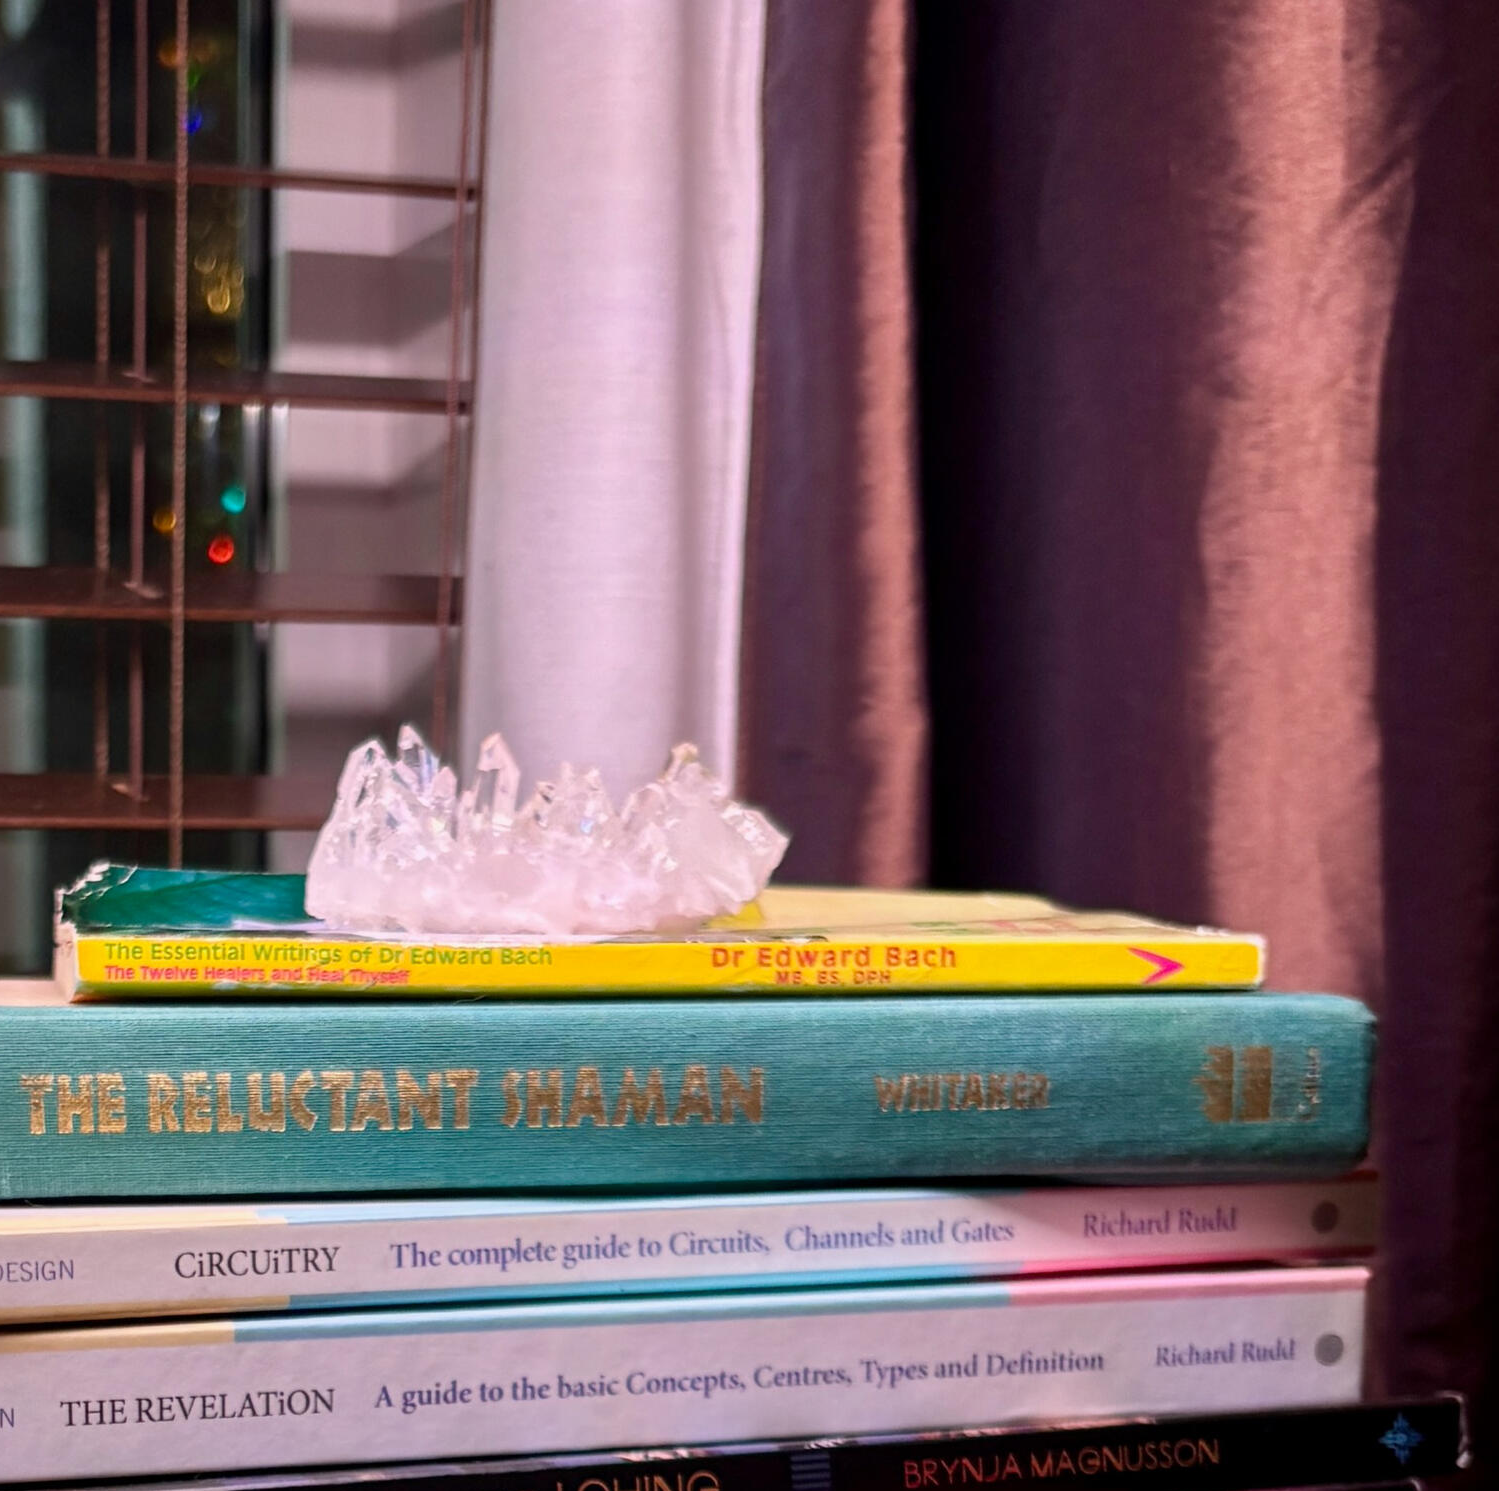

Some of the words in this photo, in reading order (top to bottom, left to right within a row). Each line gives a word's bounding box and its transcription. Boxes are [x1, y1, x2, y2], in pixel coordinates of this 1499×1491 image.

[105, 943, 142, 960] The
[150, 943, 245, 961] Essential
[252, 944, 341, 966] Writings
[350, 946, 372, 963] of
[380, 947, 403, 963] Dr
[411, 947, 492, 965] Edward
[501, 947, 552, 965] Bach
[711, 947, 744, 967] Dr
[757, 946, 870, 967] Edward
[886, 946, 957, 968] Bach
[105, 966, 135, 980] The
[141, 966, 197, 980] Twelve
[21, 1072, 126, 1137] THE
[148, 1069, 478, 1133] RELUCTANT
[502, 1064, 765, 1128] SHAMAN
[872, 1071, 1053, 1113] WHITAKER
[1082, 1209, 1171, 1238] Richard
[1179, 1207, 1239, 1235] Rudd
[390, 1242, 441, 1270] The
[448, 1238, 556, 1272] complete
[563, 1233, 632, 1269] guide
[637, 1236, 662, 1258] to
[785, 1221, 895, 1253] Channels
[900, 1219, 945, 1246] and
[951, 1218, 1016, 1245] Gates
[1155, 1342, 1237, 1368] Richard
[1241, 1337, 1297, 1363] Rudd
[374, 1385, 394, 1409] A
[401, 1379, 473, 1414] guide
[480, 1383, 504, 1404] to
[511, 1377, 551, 1402] the
[558, 1375, 619, 1399] basic
[626, 1369, 746, 1400] Concepts,
[754, 1362, 853, 1391] Centres,
[860, 1358, 930, 1389] Types
[933, 1355, 979, 1379] and
[986, 1349, 1104, 1376] Definition
[60, 1399, 127, 1428] THE
[903, 1450, 1023, 1490] BRYNJA
[1031, 1438, 1220, 1477] MAGNUSSON
